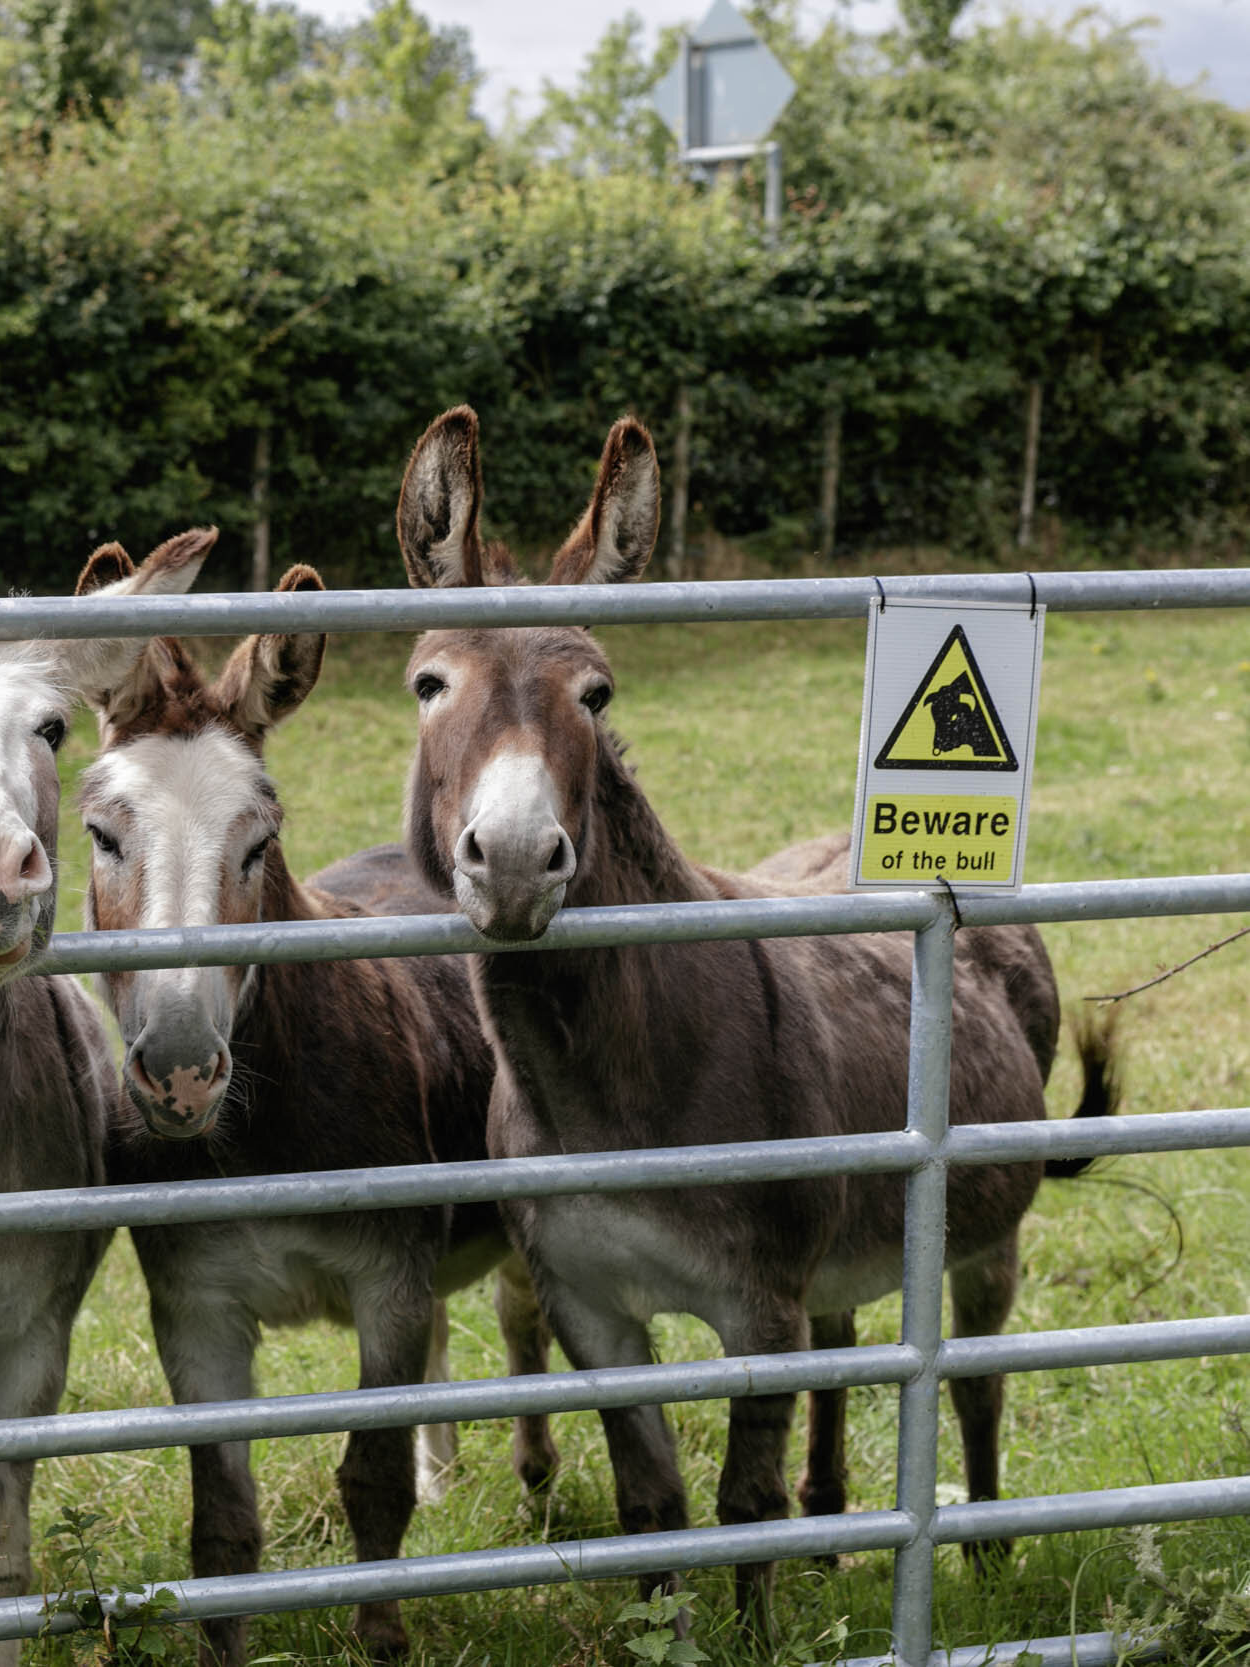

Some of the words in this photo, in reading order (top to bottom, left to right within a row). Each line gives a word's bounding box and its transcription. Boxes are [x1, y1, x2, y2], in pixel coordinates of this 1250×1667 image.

[873, 803, 1009, 836] Beware
[882, 850, 904, 869] of
[913, 851, 946, 870] the
[956, 851, 995, 870] bull
